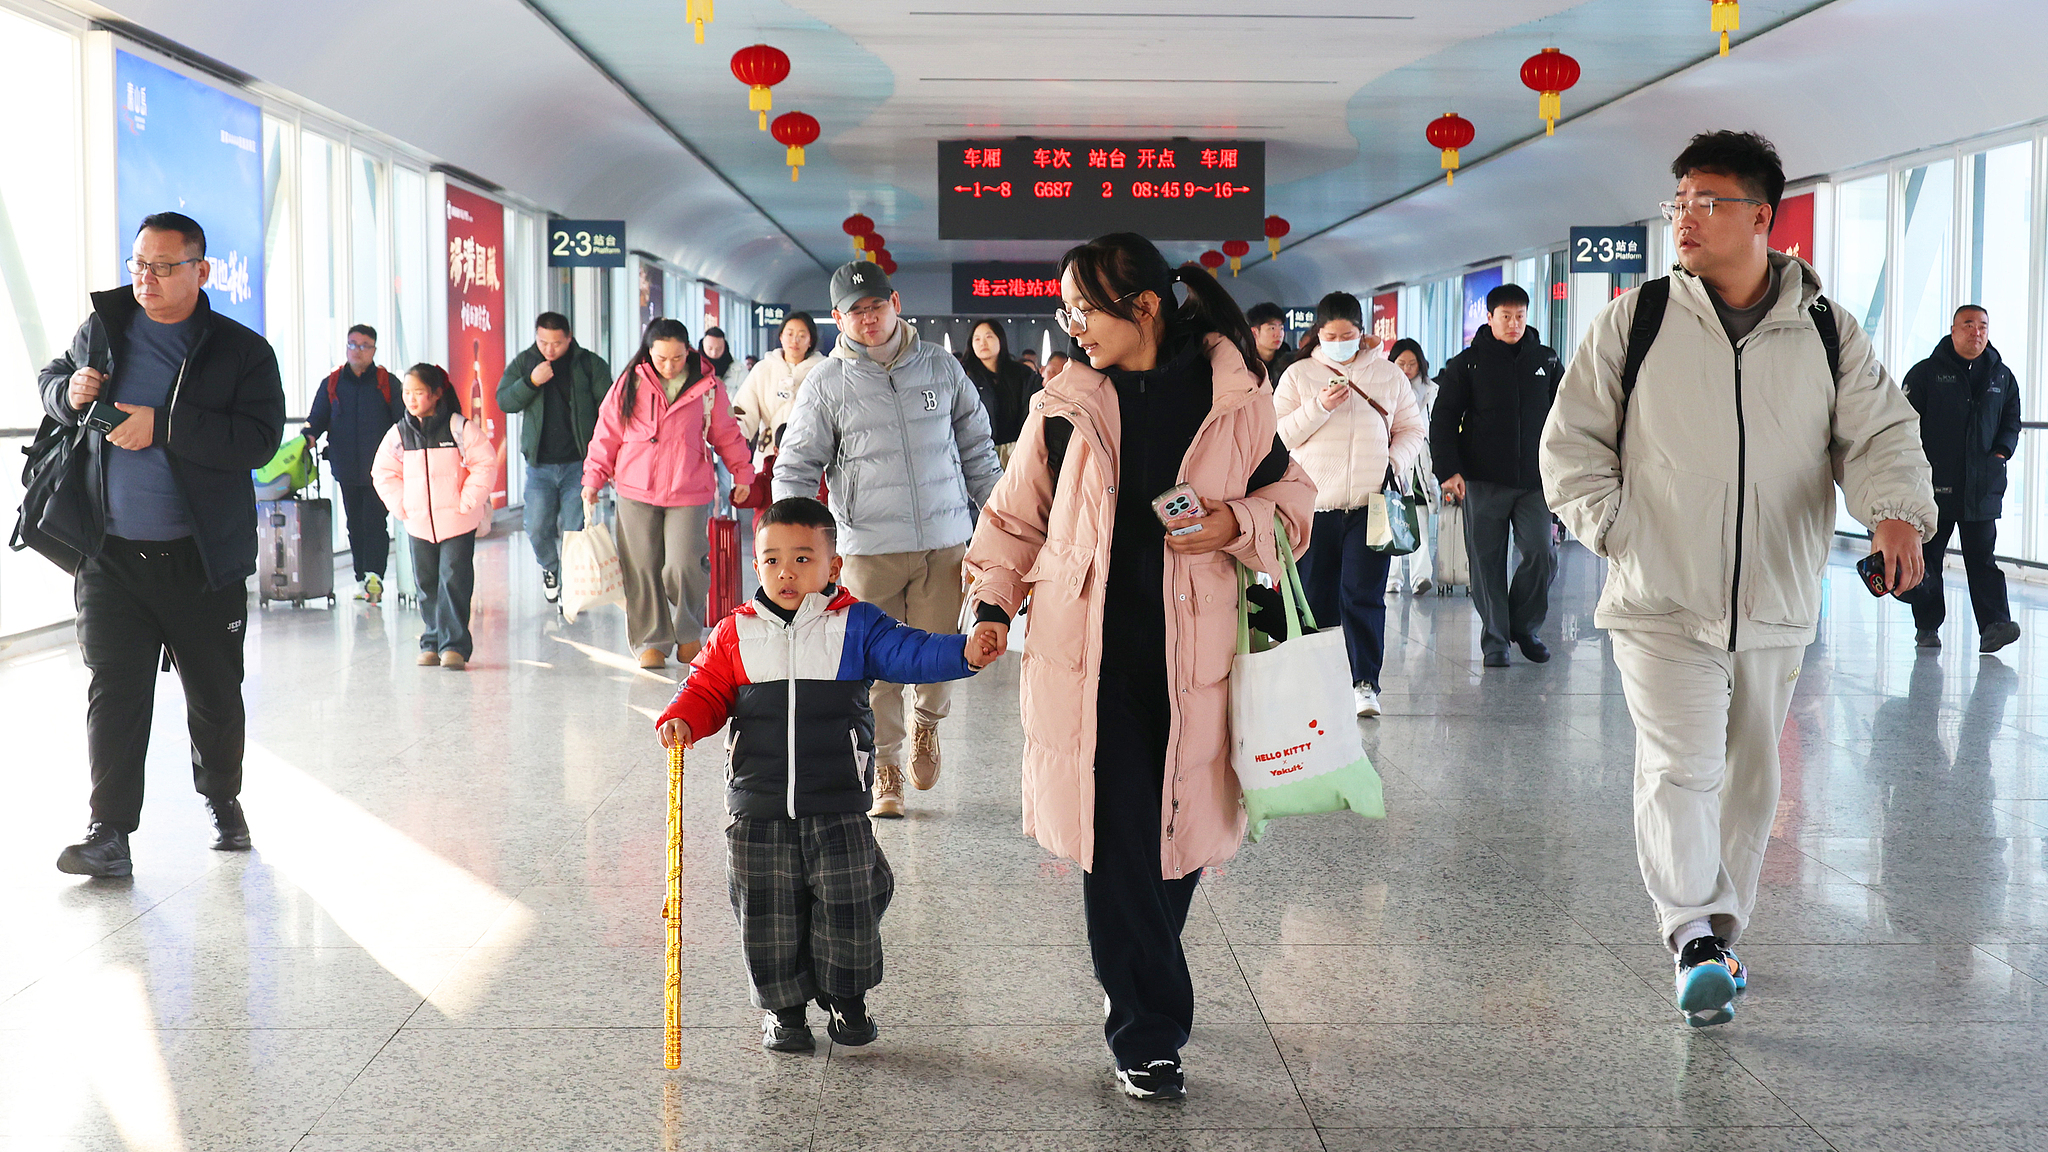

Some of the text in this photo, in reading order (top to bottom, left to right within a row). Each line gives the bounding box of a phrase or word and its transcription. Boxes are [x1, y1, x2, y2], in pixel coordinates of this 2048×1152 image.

[963, 148, 1239, 169] 车厢 车次 站台 开点 车厢
[1033, 181, 1073, 198] G687
[1101, 181, 1113, 198] 2
[1131, 181, 1181, 198] 08:45
[593, 233, 617, 247] 站台
[1615, 240, 1638, 252] 站台
[1615, 252, 1642, 260] Platform
[754, 305, 764, 327] 1
[765, 307, 784, 318] 站台
[1285, 309, 1294, 330] 1
[1295, 311, 1314, 321] 站台
[922, 389, 938, 411] B
[1254, 742, 1311, 763] HELLO KITTY
[1270, 763, 1303, 777] Yakult
